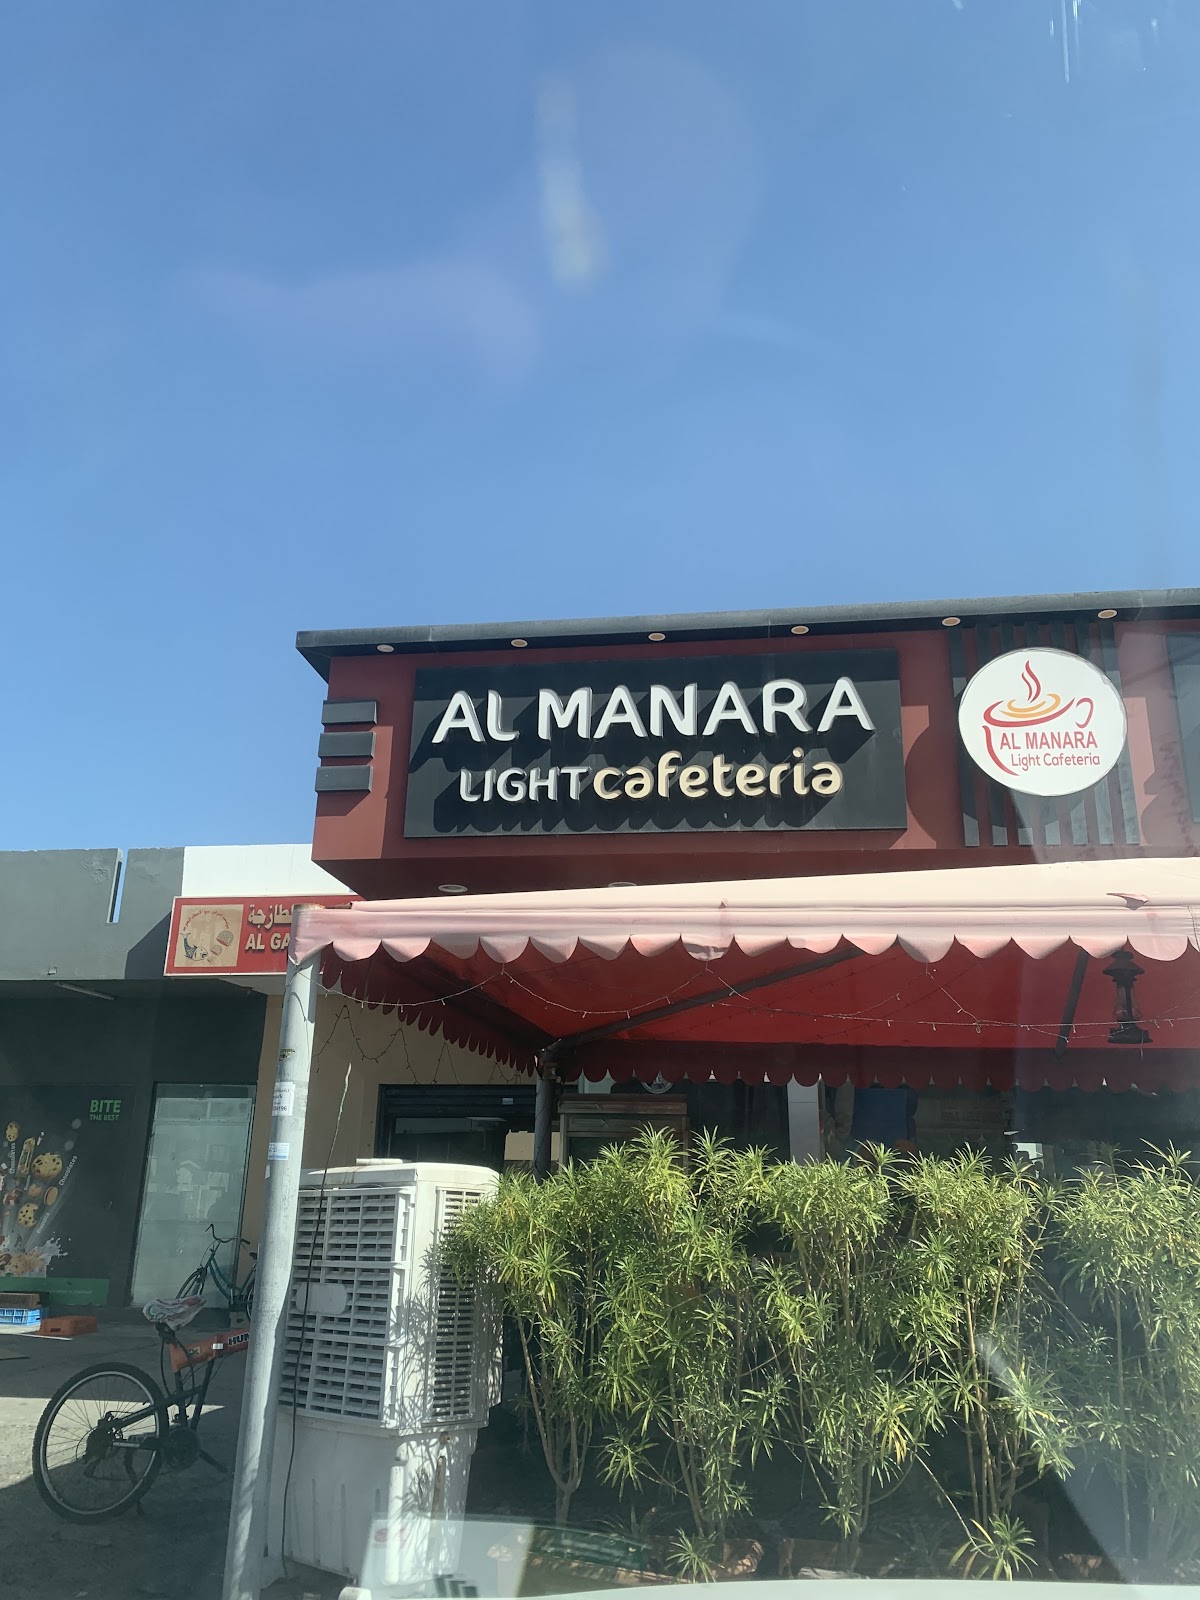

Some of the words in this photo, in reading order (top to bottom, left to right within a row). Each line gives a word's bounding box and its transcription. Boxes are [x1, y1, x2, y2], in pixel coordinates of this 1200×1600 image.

[432, 689, 520, 743] AL
[539, 677, 875, 742] MANARA
[1000, 732, 1021, 750] AL
[1025, 731, 1098, 750] MANARA
[1011, 753, 1041, 771] Light
[1043, 753, 1100, 767] Cafeteria
[245, 933, 265, 950] AL
[90, 1100, 121, 1113] BITE
[59, 1155, 77, 1186] Chocolates
